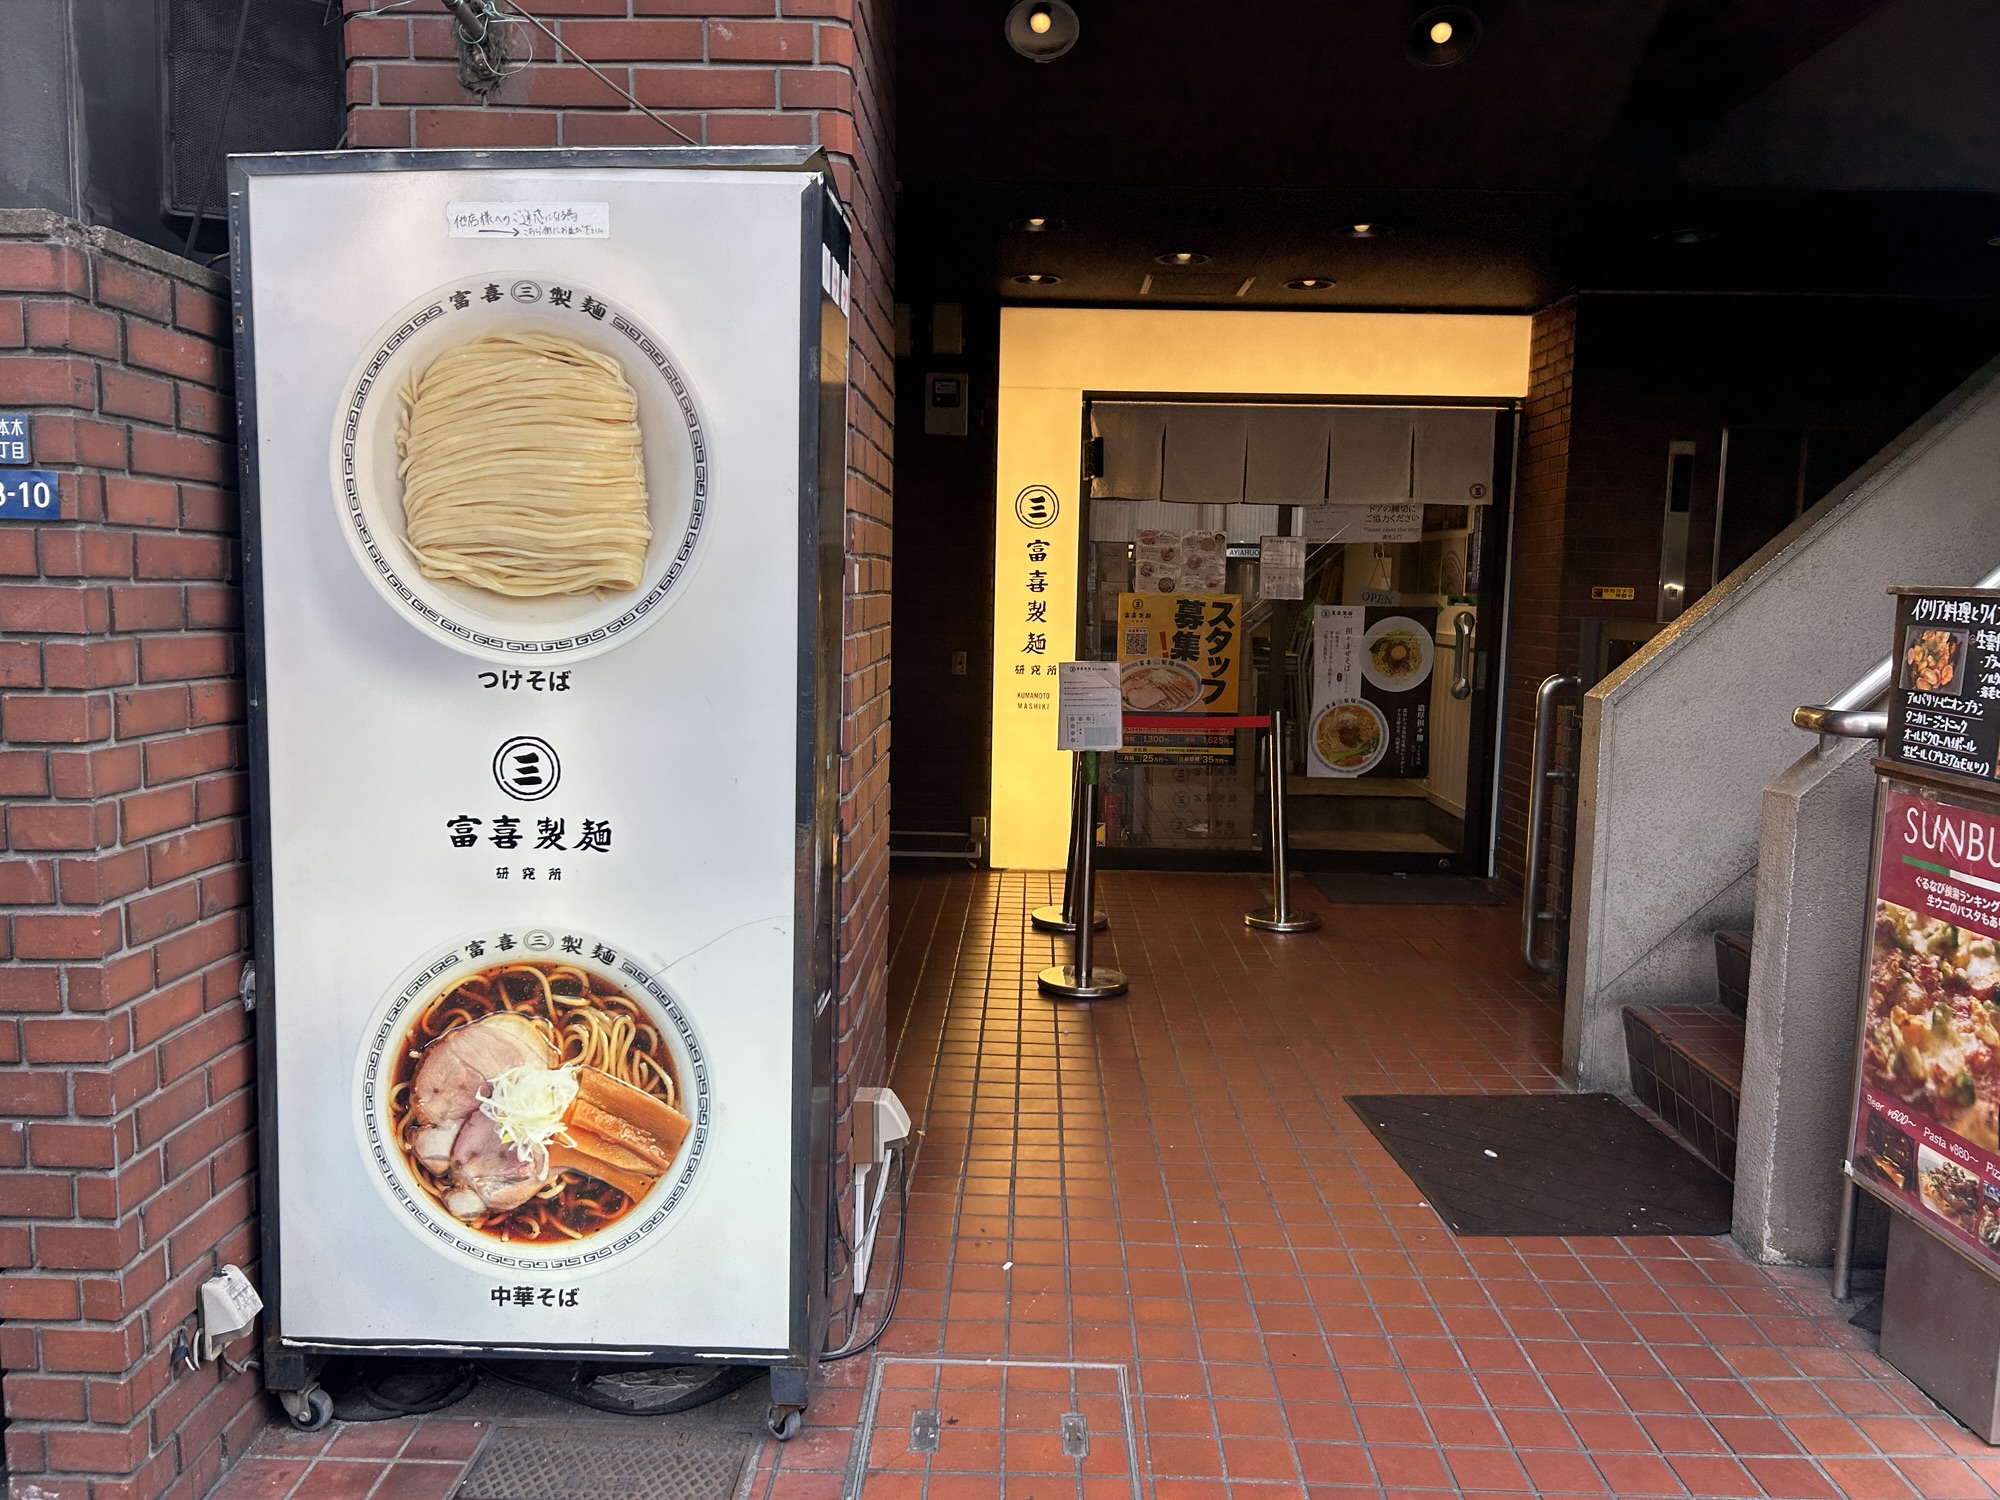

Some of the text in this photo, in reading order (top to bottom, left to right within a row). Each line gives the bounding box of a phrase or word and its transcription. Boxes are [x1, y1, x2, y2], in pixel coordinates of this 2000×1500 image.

[1021, 539, 1050, 655] 富喜製麺
[1361, 591, 1393, 605] OPEN
[1170, 599, 1206, 662] 募集
[1201, 602, 1235, 705] スタッフ
[1014, 664, 1057, 675] 研究所
[478, 670, 572, 692] つけそば
[1017, 692, 1050, 700] KUMAMOTO
[1017, 702, 1050, 710] MASHIKI
[446, 814, 612, 852] 富喜製麺
[495, 866, 562, 881] 研究所
[1926, 894, 2000, 930] 生ウニのパスタもあ
[1866, 1094, 1885, 1112] Beer
[1923, 1127, 1948, 1149] Pasta
[1986, 1161, 2000, 1180] Piz
[491, 1286, 580, 1307] 中華そば
